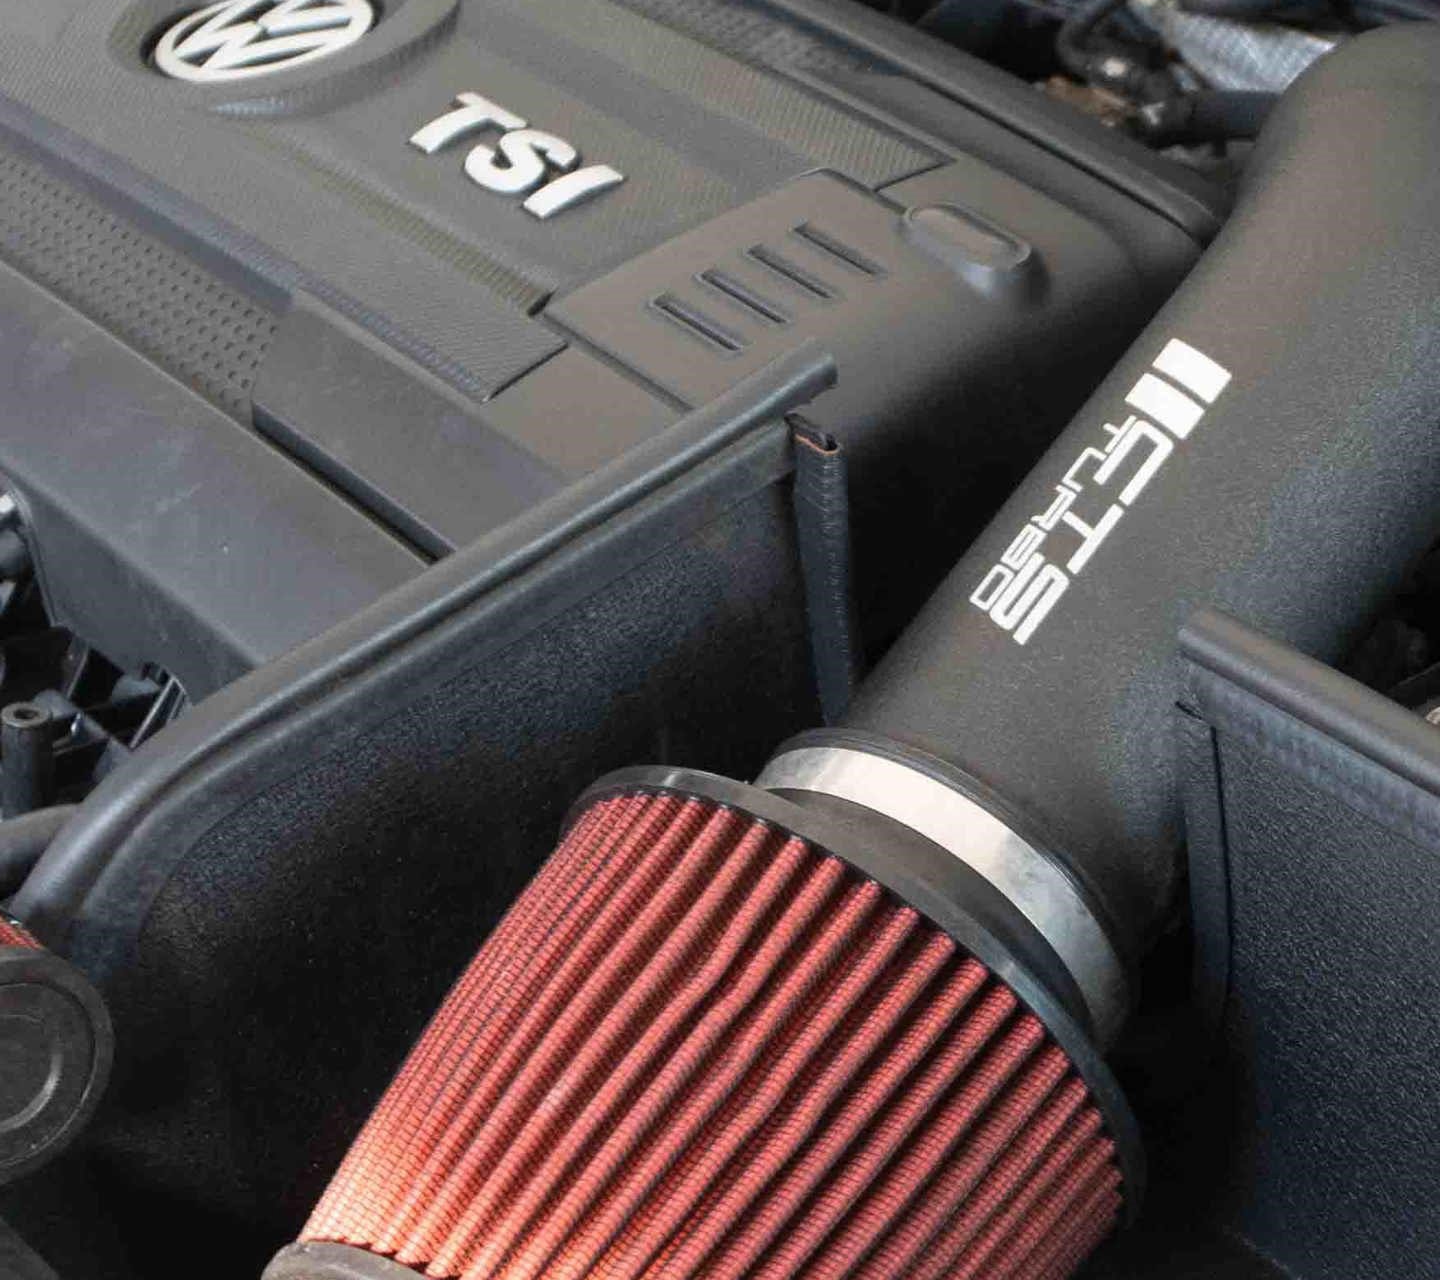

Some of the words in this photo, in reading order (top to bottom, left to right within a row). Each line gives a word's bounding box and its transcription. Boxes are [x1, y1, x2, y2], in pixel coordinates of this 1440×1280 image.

[408, 92, 624, 219] TSI
[970, 415, 1137, 611] TURBO
[989, 420, 1174, 646] CTS
